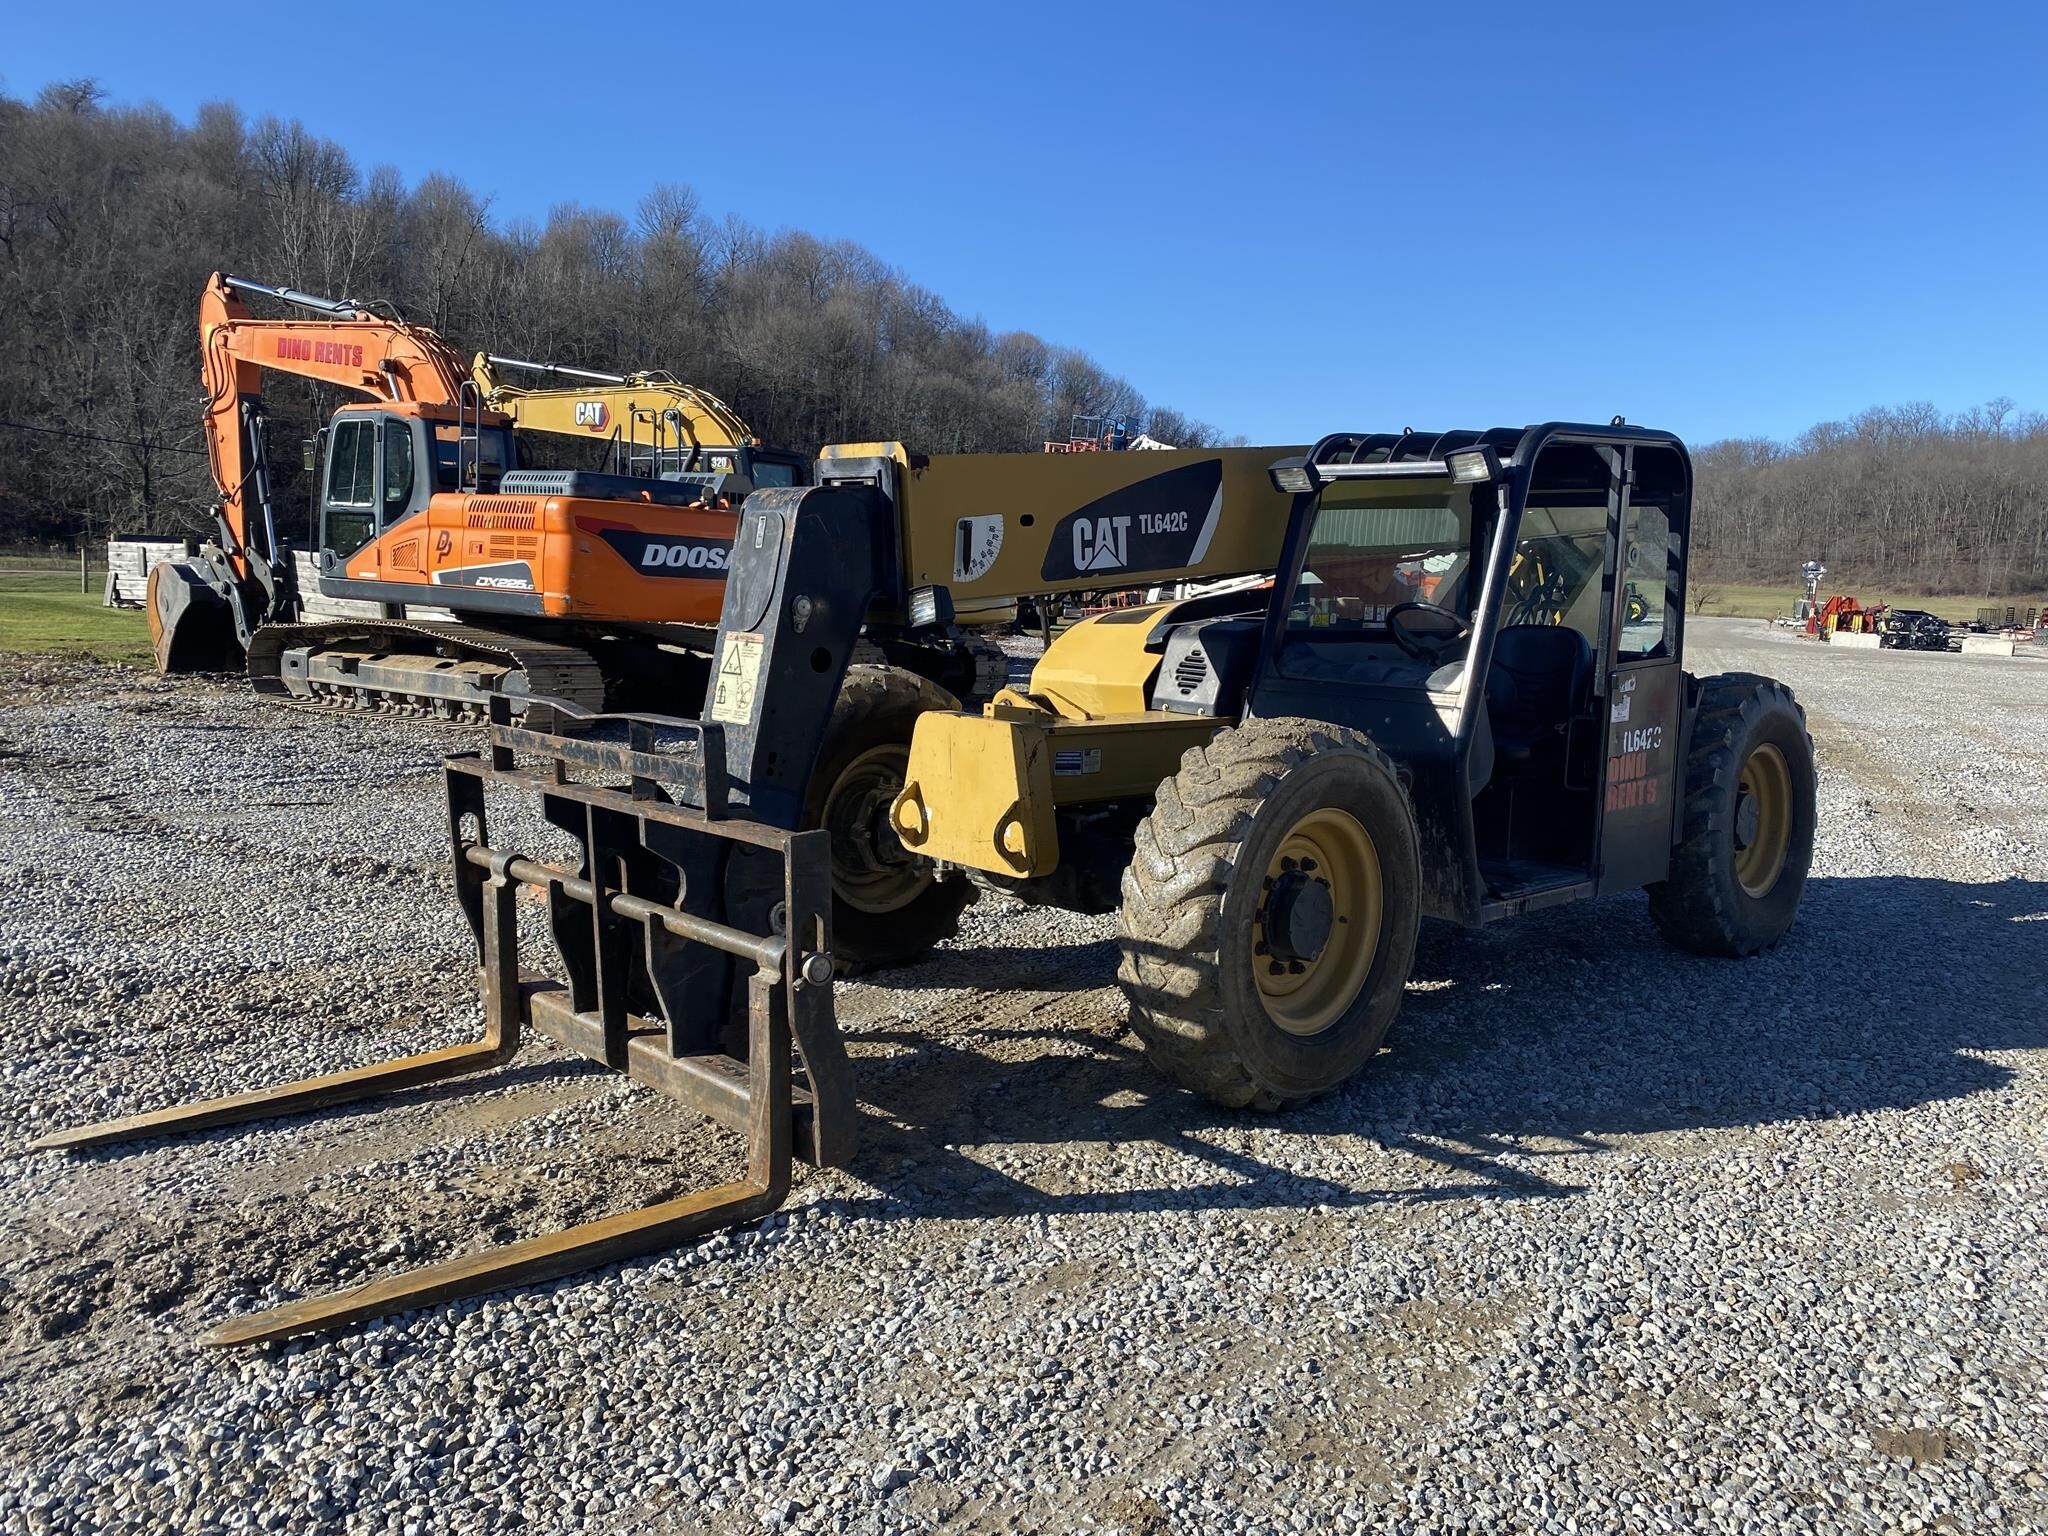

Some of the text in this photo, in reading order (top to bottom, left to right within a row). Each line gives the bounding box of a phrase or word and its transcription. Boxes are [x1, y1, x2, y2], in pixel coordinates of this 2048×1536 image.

[277, 337, 363, 367] DINO RENTS
[575, 402, 603, 425] CAT
[711, 457, 727, 469] 320
[1139, 511, 1188, 534] TL642C
[1073, 516, 1131, 570] CAT
[1608, 751, 1648, 783] DINO
[1606, 778, 1657, 811] RENTS
